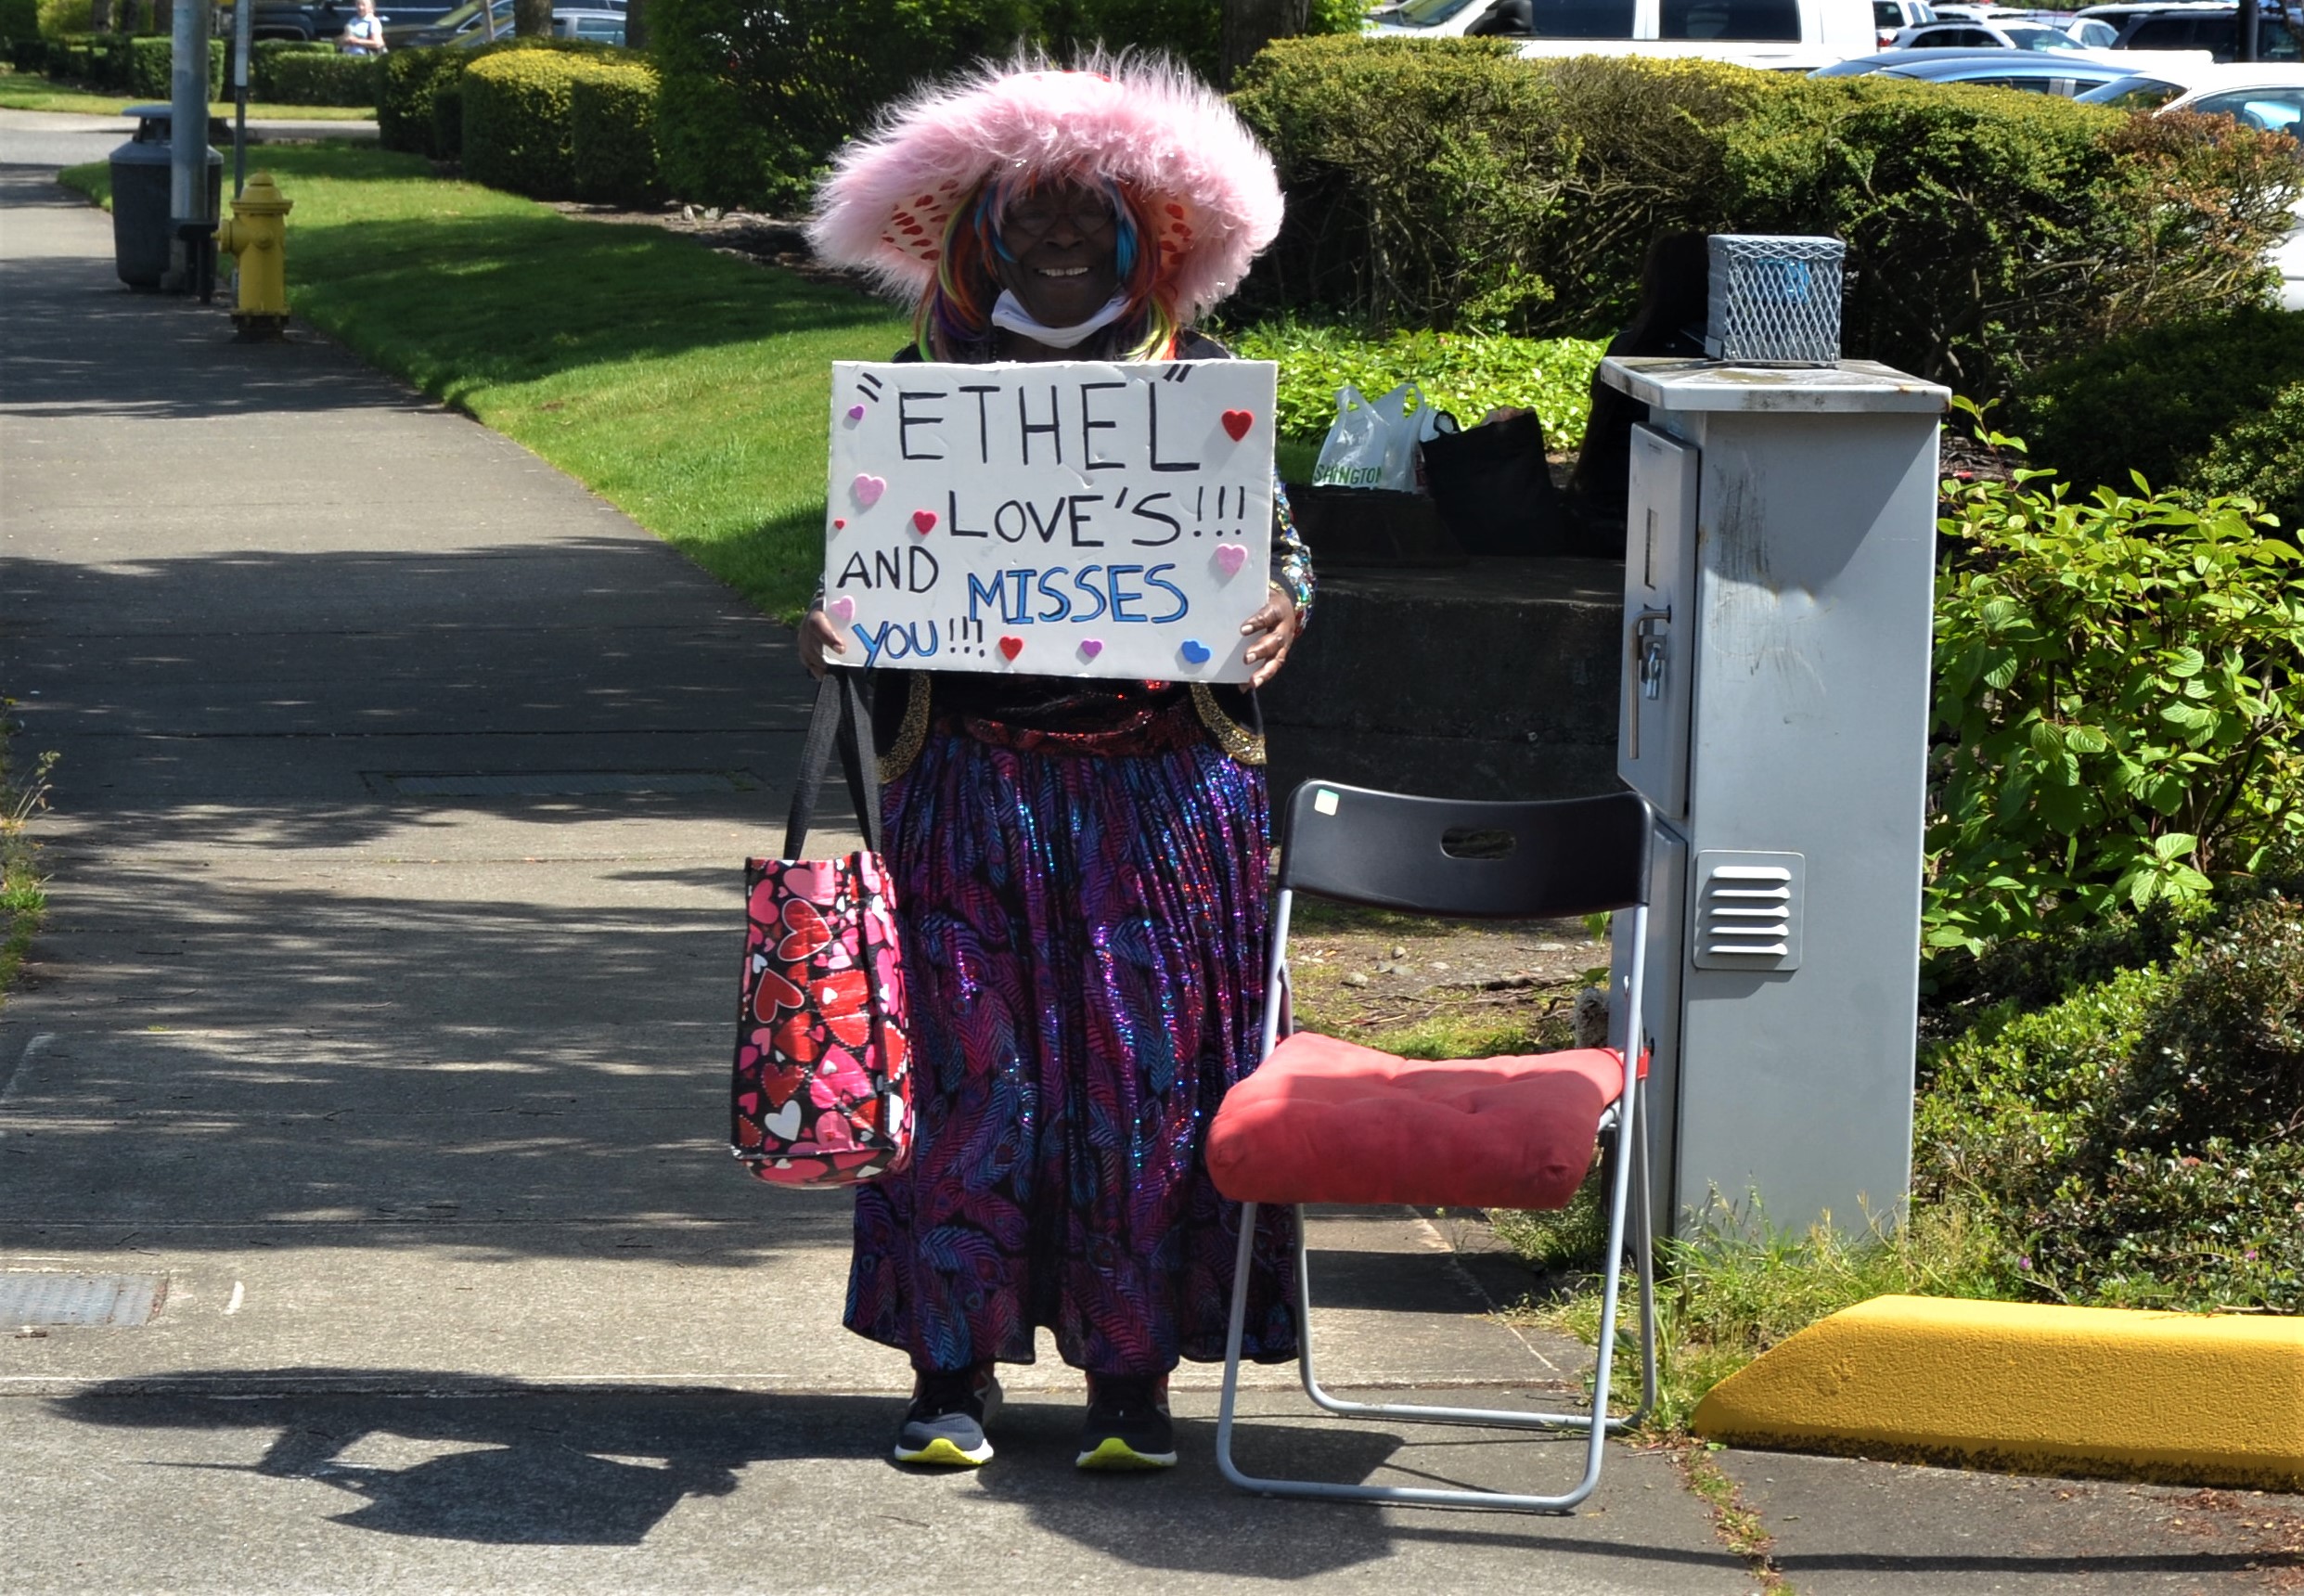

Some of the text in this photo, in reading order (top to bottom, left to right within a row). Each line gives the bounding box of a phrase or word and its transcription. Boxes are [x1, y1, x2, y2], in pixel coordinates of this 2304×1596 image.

[856, 364, 1201, 471] "ETHEL"
[949, 485, 1245, 547] LOVE'S!!!
[836, 545, 1190, 625] AND MISSES
[852, 616, 986, 668] YOU!!!
